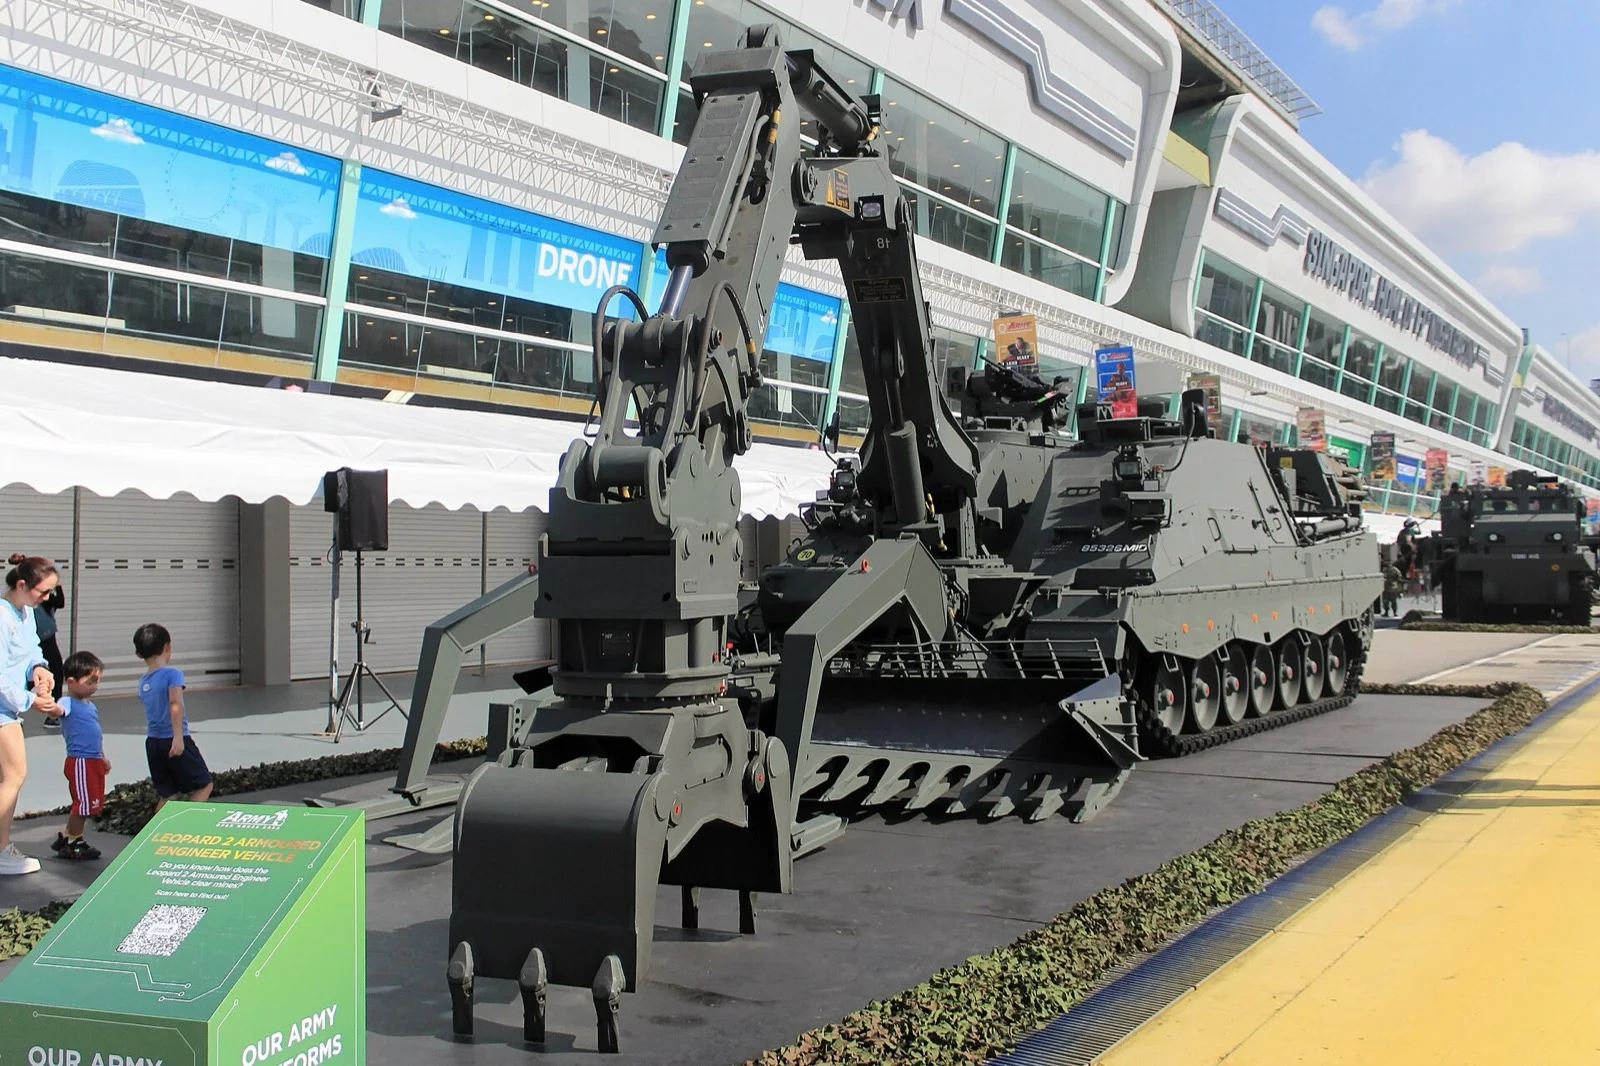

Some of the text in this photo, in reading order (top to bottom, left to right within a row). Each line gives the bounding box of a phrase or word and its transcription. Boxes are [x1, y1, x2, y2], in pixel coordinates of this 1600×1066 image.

[538, 243, 633, 289] DRONE
[1081, 544, 1148, 552] 85326MID
[221, 811, 276, 824] ARMY
[151, 833, 322, 850] LEOPARD 2 ARMOURED
[155, 845, 297, 862] ENGINEER VEHICLE
[159, 861, 171, 869] Do
[189, 863, 214, 871] know
[146, 868, 183, 877] Leopard
[188, 871, 233, 880] Armoured
[231, 873, 270, 883] Engineer
[161, 877, 244, 889] Vehicle clear mines?
[242, 1003, 338, 1066] OUR ARMY
[28, 1045, 81, 1066] OUR
